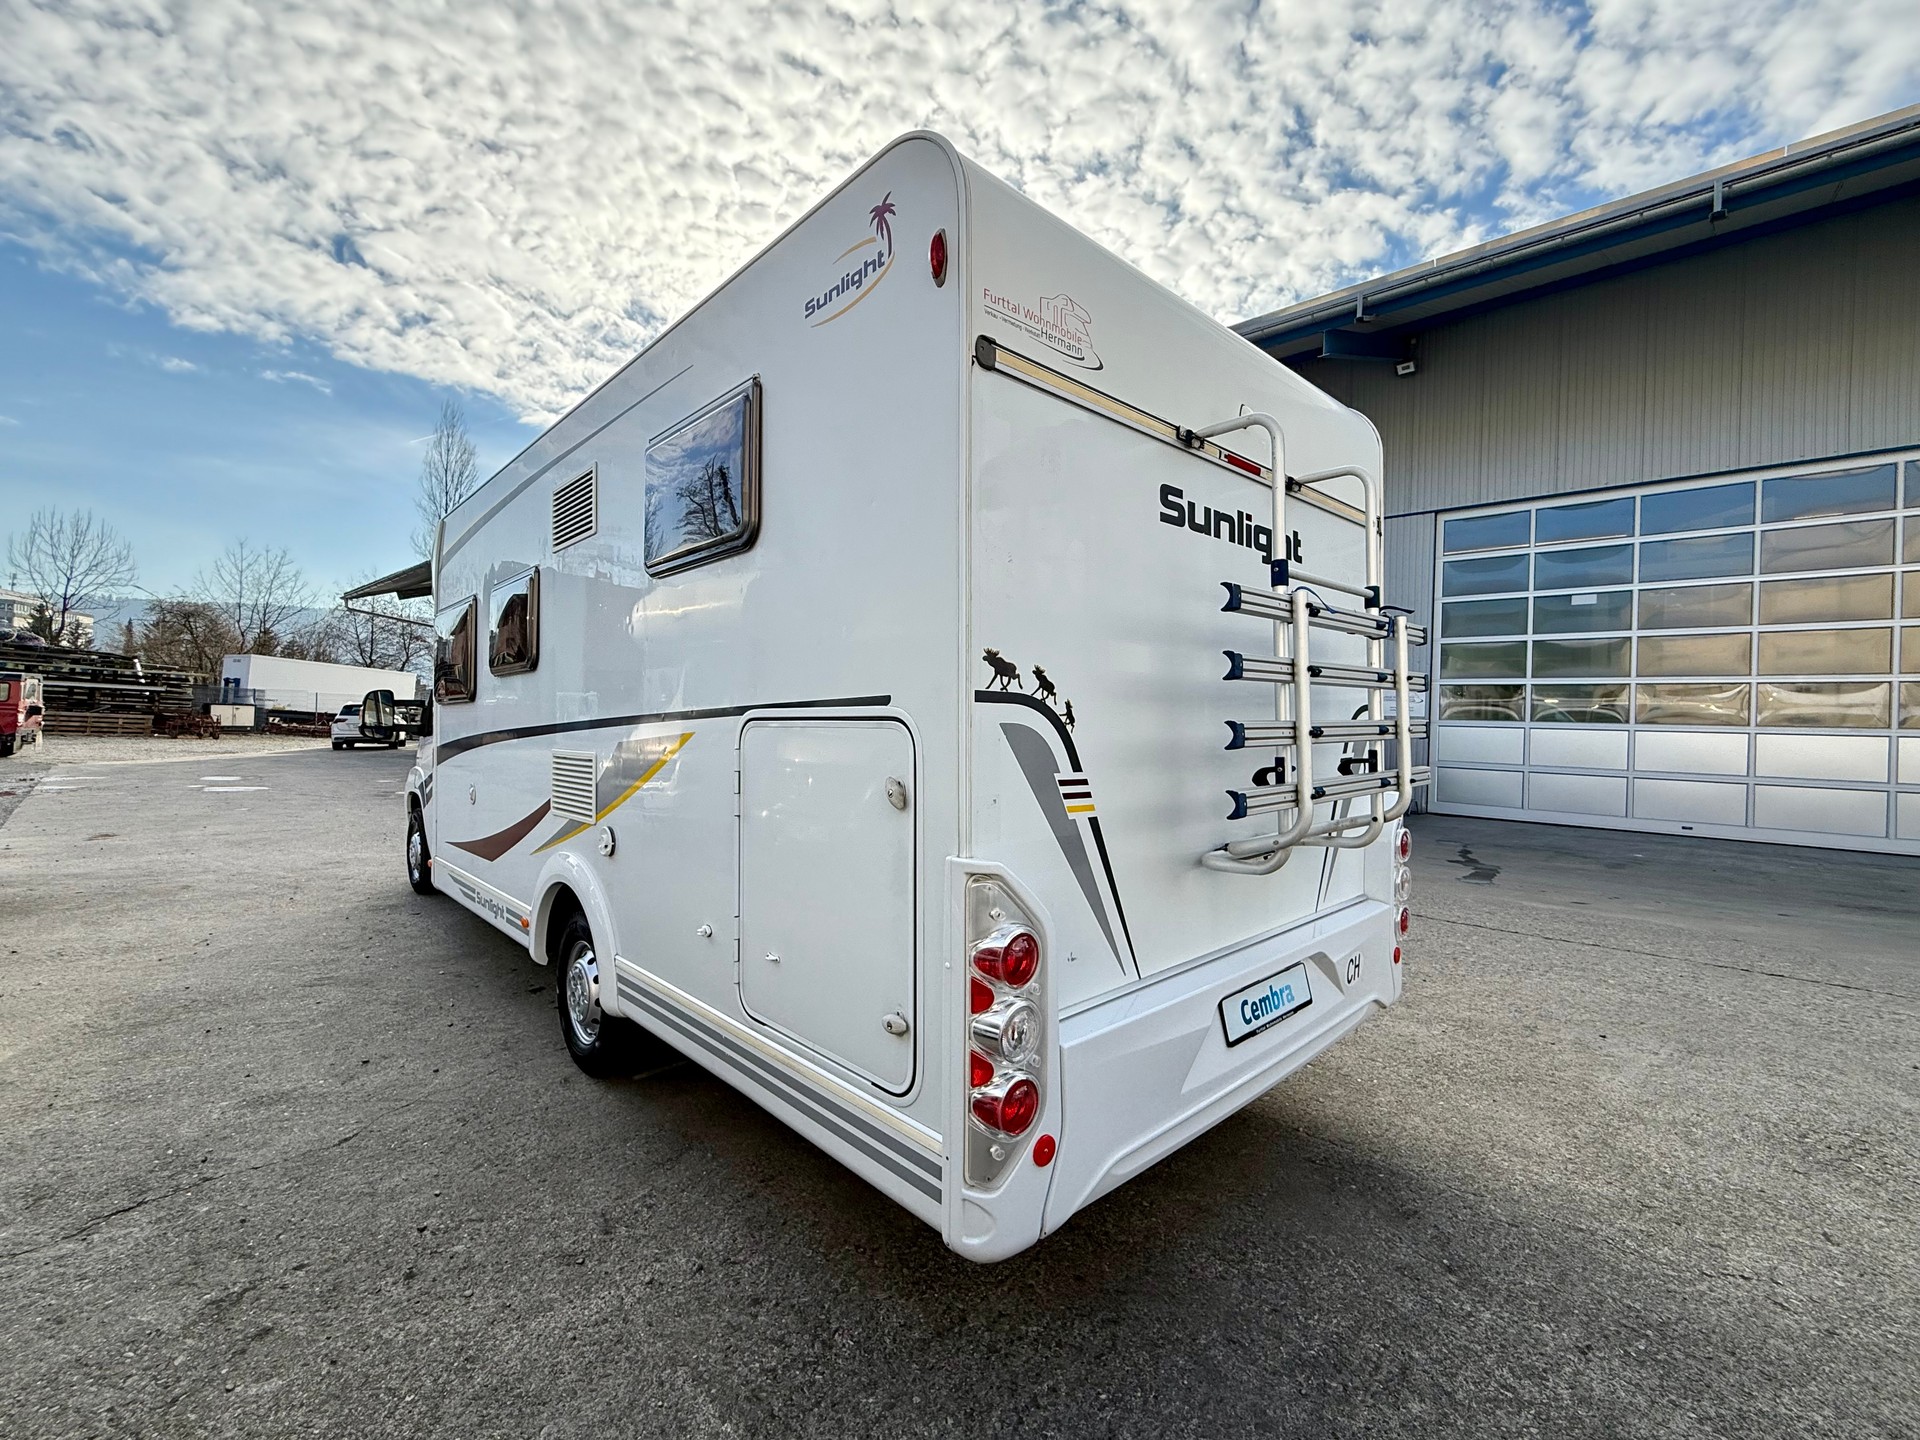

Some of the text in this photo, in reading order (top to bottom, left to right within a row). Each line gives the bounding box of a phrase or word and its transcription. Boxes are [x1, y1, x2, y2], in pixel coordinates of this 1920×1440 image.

[804, 249, 885, 319] Sunlight
[983, 287, 1083, 346] Furttal Wohnmobile
[1040, 326, 1083, 357] Hermann
[476, 891, 505, 920] Sunlight
[1346, 953, 1361, 985] CH
[1240, 984, 1295, 1026] Cembra
